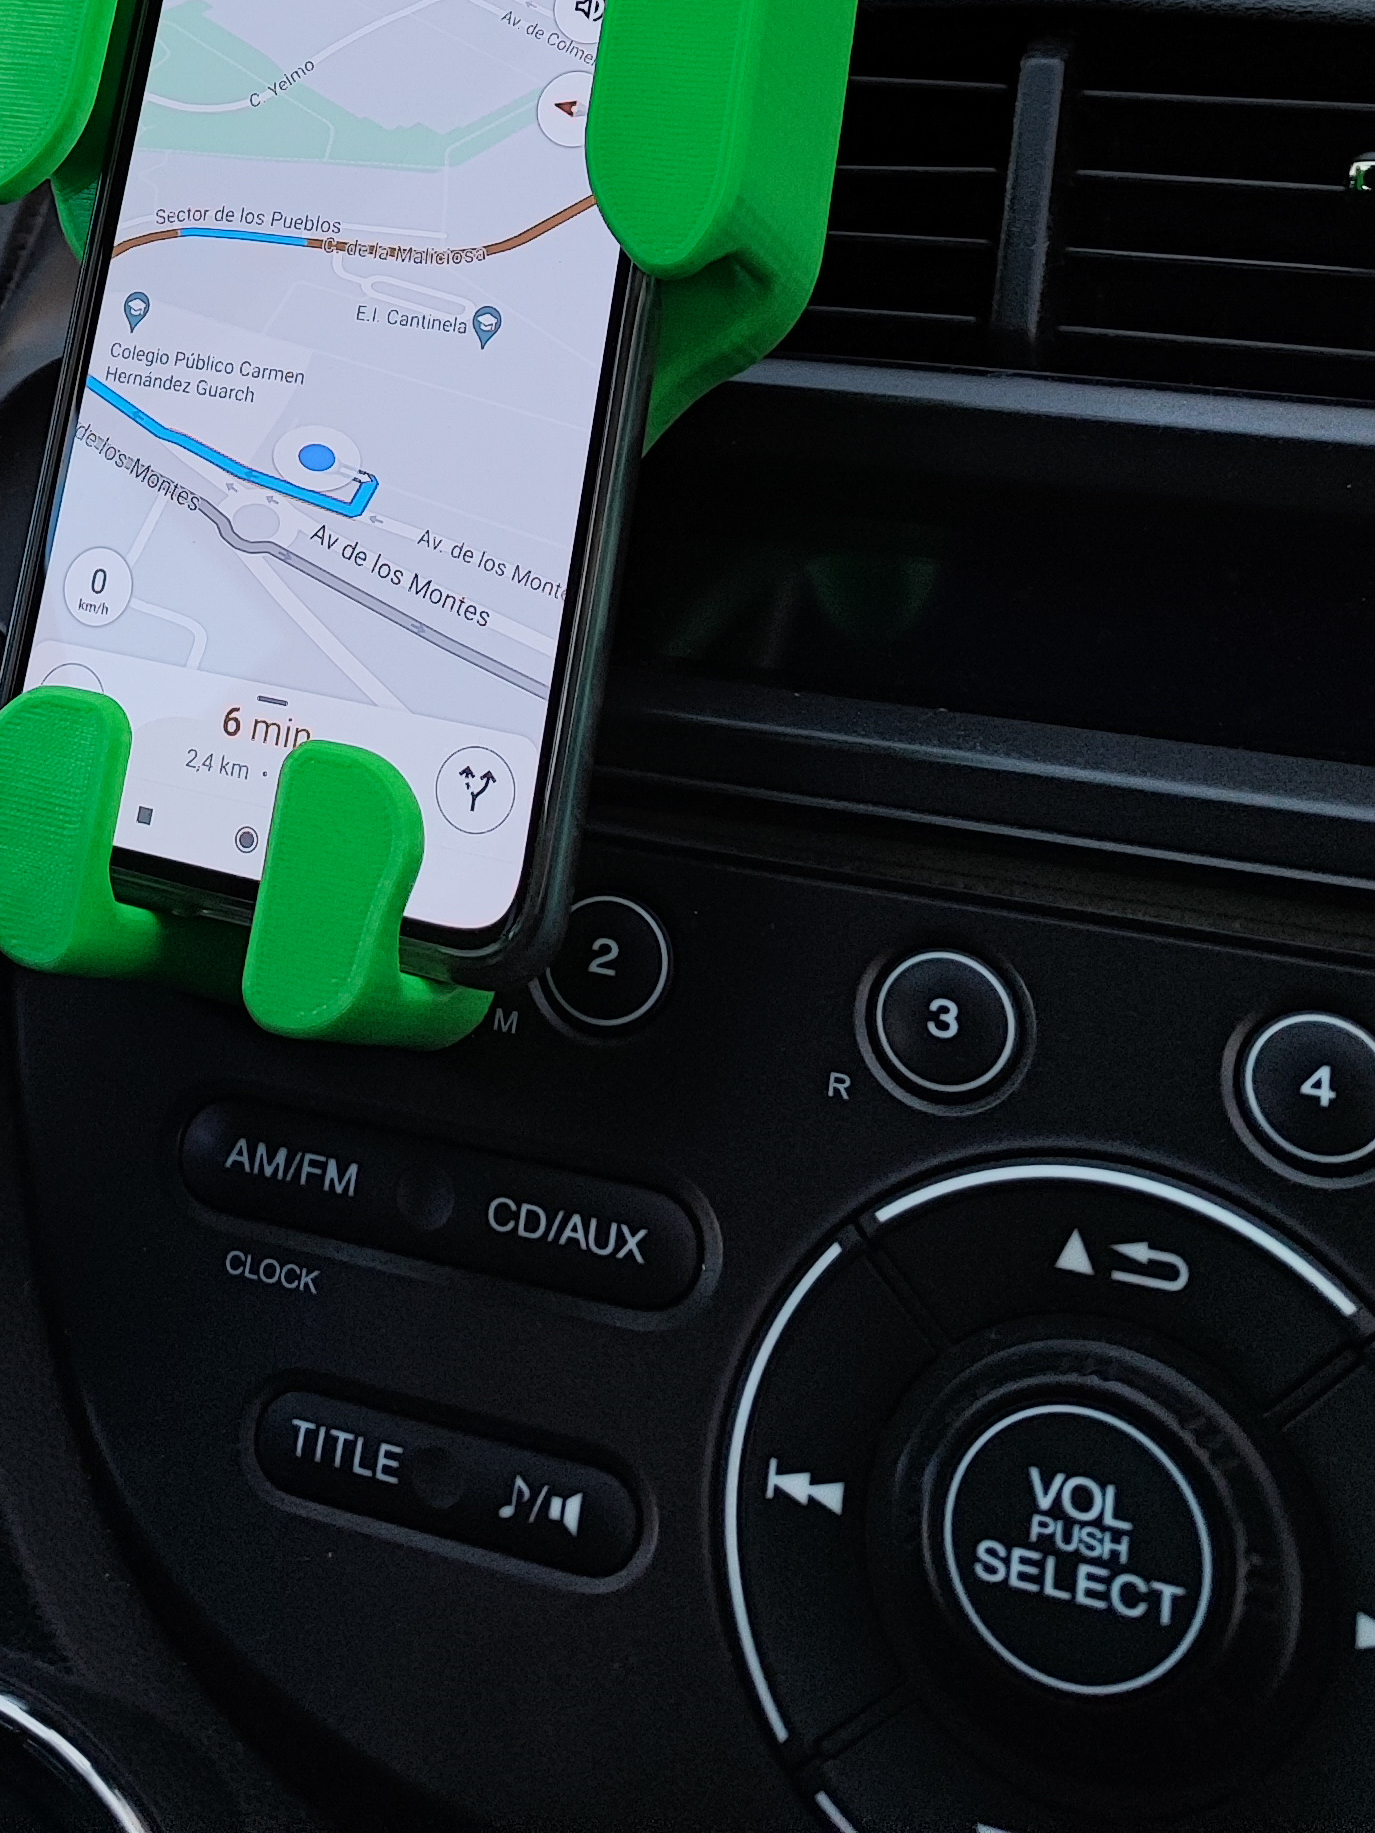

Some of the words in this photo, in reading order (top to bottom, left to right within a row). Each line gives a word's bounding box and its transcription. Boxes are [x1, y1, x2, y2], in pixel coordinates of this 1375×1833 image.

[500, 10, 522, 30] Av.
[526, 23, 545, 40] de
[249, 93, 266, 108] C.
[268, 60, 315, 96] Yelmo
[156, 208, 210, 225] Sector
[214, 206, 235, 223] de
[240, 207, 265, 226] los
[270, 211, 342, 234] Pueblos
[346, 240, 367, 258] de
[374, 242, 389, 261] la
[395, 246, 487, 266] Maliciosa
[387, 309, 468, 334] Cantinela
[105, 366, 191, 394] Hernández
[196, 380, 256, 404] Guarch
[110, 342, 170, 367] Colegio
[174, 351, 234, 375] Público
[240, 361, 305, 386] Carmen
[75, 423, 97, 447] de
[99, 436, 128, 468] los
[129, 457, 201, 511] Montes
[417, 529, 443, 554] Av.
[451, 542, 474, 564] de
[477, 551, 507, 577] los
[91, 568, 107, 595] 0
[310, 524, 339, 551] Av
[341, 541, 368, 567] de
[371, 553, 405, 586] los
[408, 573, 491, 627] Montes
[78, 597, 109, 616] km/h
[223, 707, 241, 737] 6
[251, 717, 311, 749] min
[185, 748, 215, 774] 2,4
[219, 754, 249, 780] km
[588, 937, 620, 977] 2
[493, 1007, 519, 1034] M
[927, 998, 959, 1039] 3
[827, 1071, 851, 1100] R
[1300, 1065, 1337, 1108] 4
[226, 1137, 359, 1198] AM/FM
[487, 1196, 648, 1265] CD/AUX
[225, 1249, 321, 1295] CLOCK
[292, 1418, 404, 1485] TITLE
[1029, 1466, 1133, 1531] VOL
[1029, 1513, 1130, 1565] PUSH
[974, 1538, 1187, 1627] SELECT
